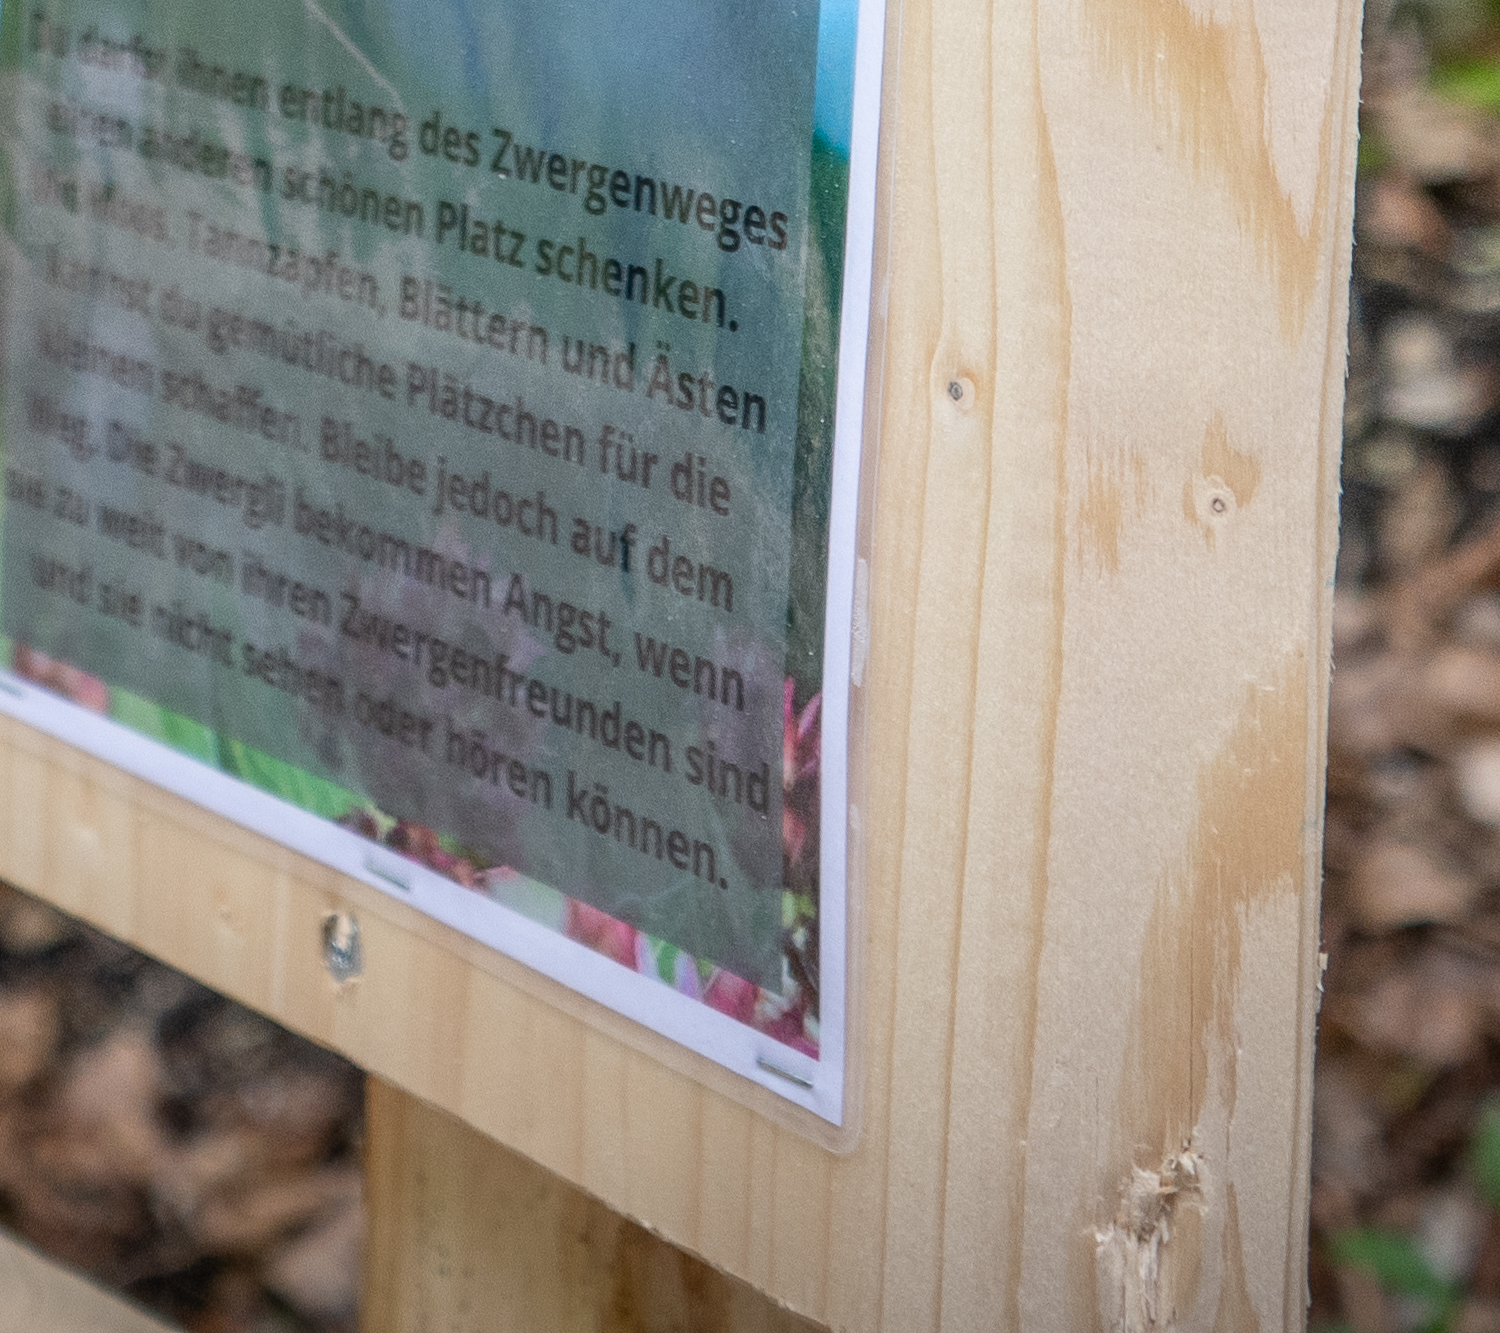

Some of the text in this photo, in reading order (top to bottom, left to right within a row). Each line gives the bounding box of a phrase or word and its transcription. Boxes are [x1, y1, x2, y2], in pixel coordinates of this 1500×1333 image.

[279, 83, 409, 162] entlang
[418, 109, 481, 168] des
[489, 127, 789, 253] Zwergenweges
[279, 166, 425, 238] schönen
[434, 199, 526, 270] Platz
[534, 235, 740, 334] schenken.
[158, 285, 202, 331] du
[206, 307, 397, 401] gemütliche
[406, 362, 585, 466] Plätzchen
[599, 424, 659, 489] für
[669, 451, 732, 517] die
[399, 275, 548, 365] Blättern
[561, 335, 637, 393] und
[645, 340, 768, 434] Ästen
[292, 483, 492, 610] bekommen
[503, 572, 622, 667] Angst,
[633, 632, 746, 712] wenn
[320, 415, 426, 496] Bleibe
[431, 454, 558, 546] jedoch
[570, 516, 637, 575] auf
[646, 534, 734, 614] dem
[240, 547, 334, 627] ihren
[338, 588, 672, 775] Zwergenfreunden
[684, 738, 771, 815] sind
[240, 641, 347, 719] sehen
[353, 690, 434, 754] oder
[445, 716, 555, 812] hören
[564, 770, 729, 891] können.
